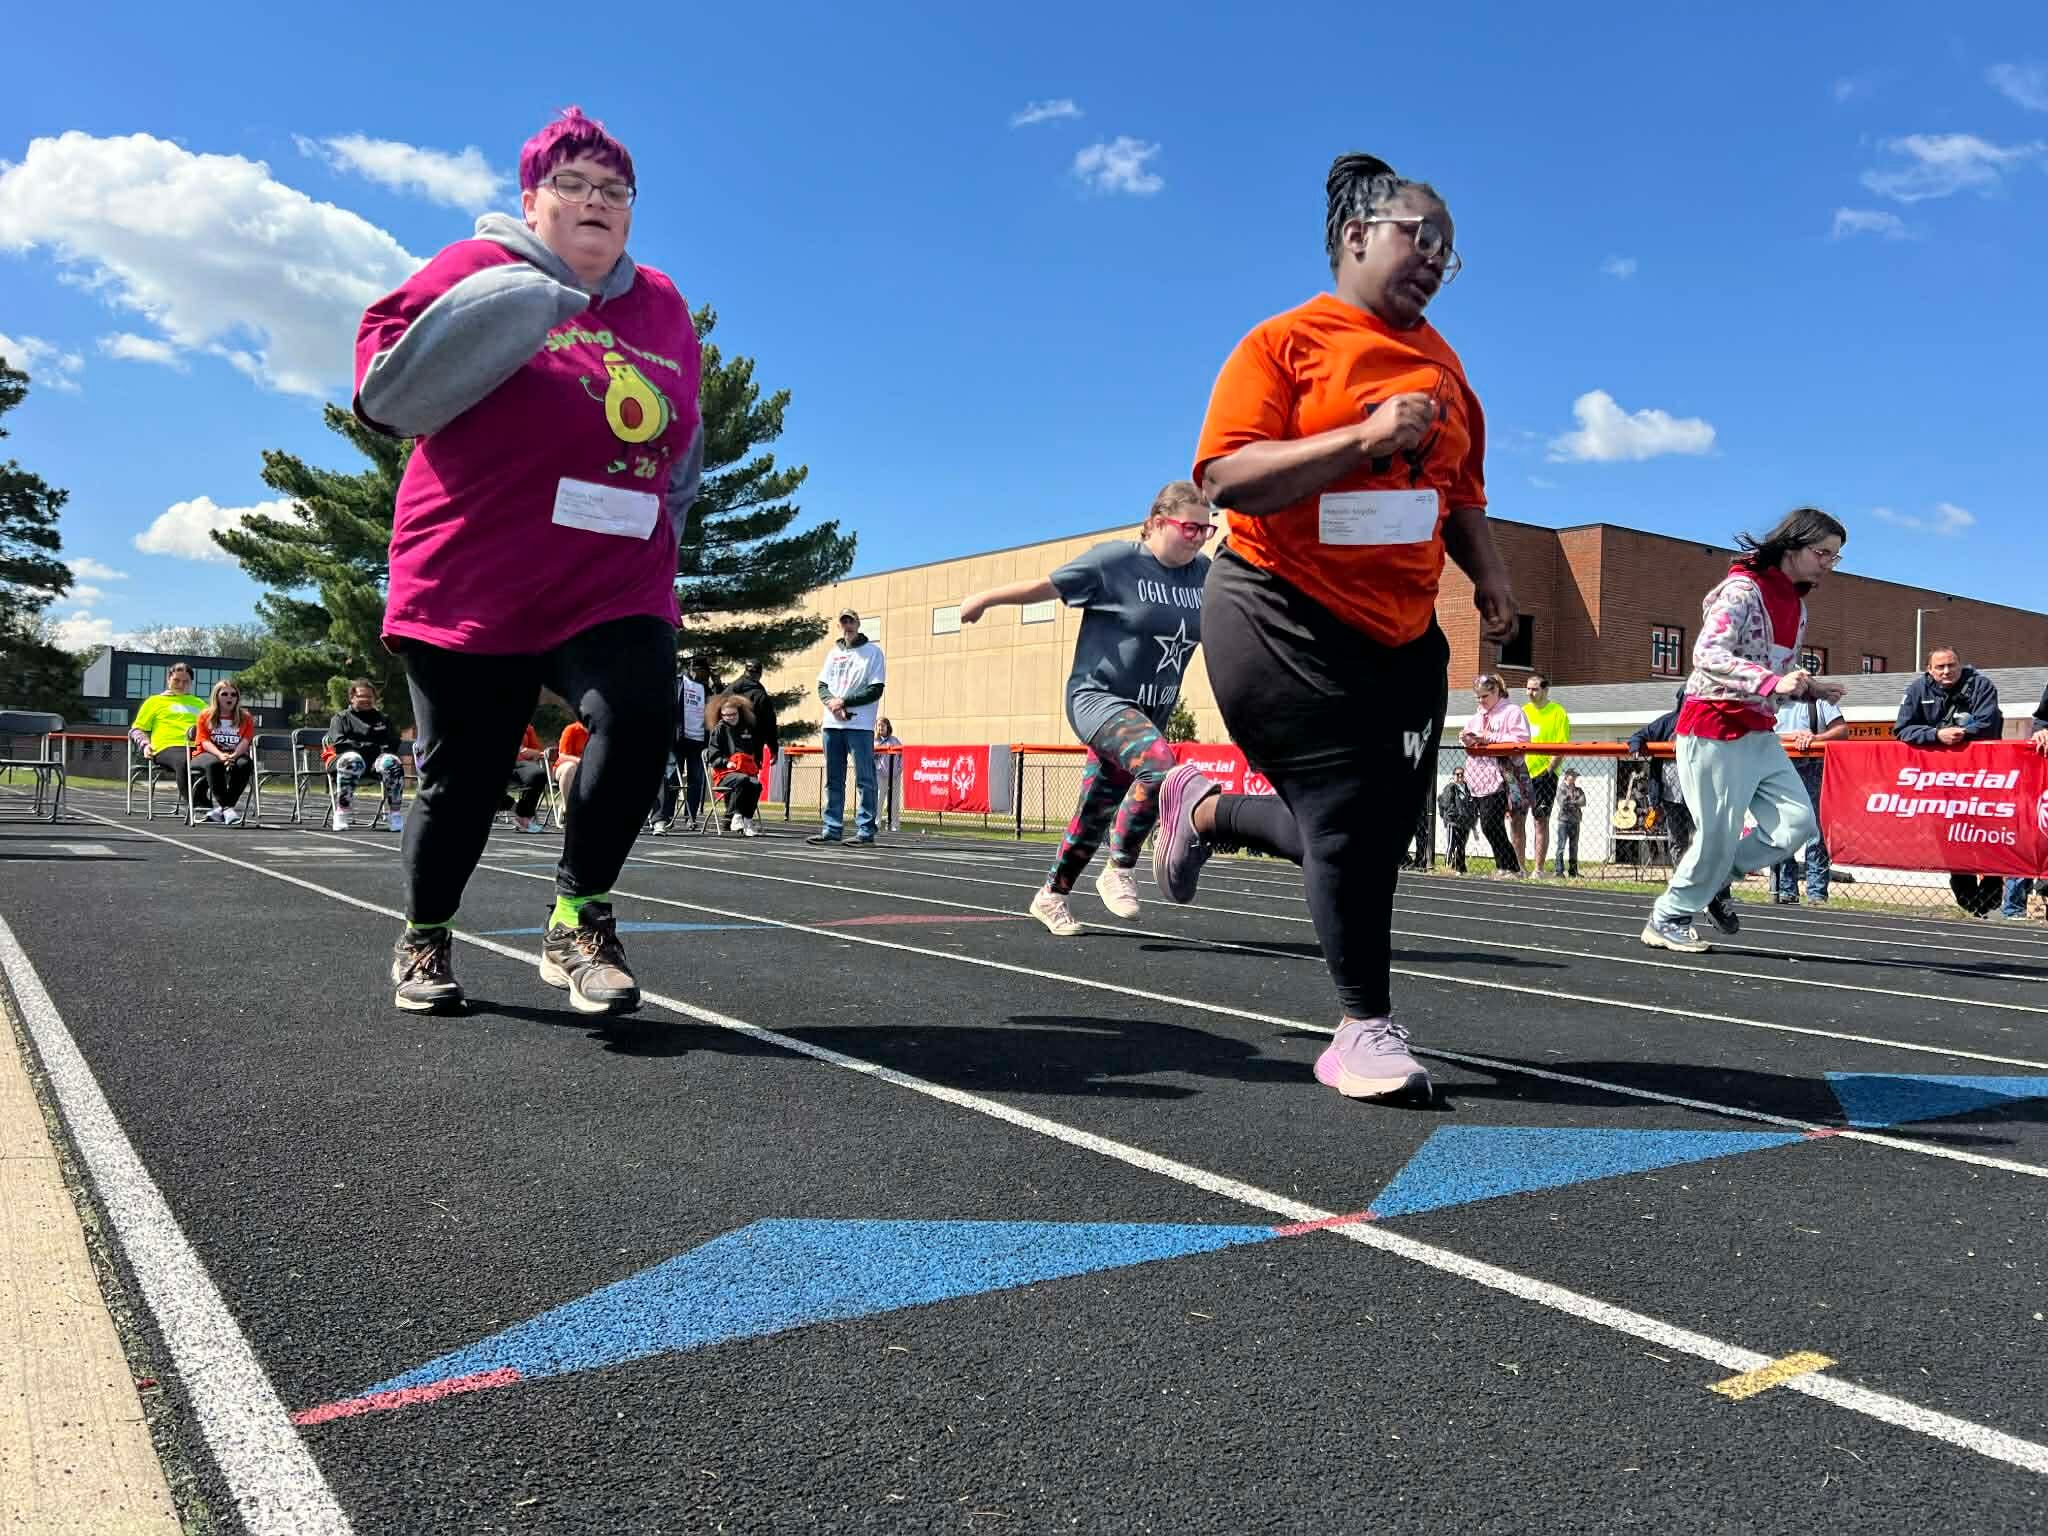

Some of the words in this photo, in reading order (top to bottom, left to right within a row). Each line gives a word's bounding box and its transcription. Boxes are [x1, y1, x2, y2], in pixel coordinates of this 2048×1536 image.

[1172, 585, 1204, 609] COUN
[1897, 768, 2019, 790] Special
[1866, 793, 2016, 818] Olympics
[1947, 823, 2016, 846] Illinois
